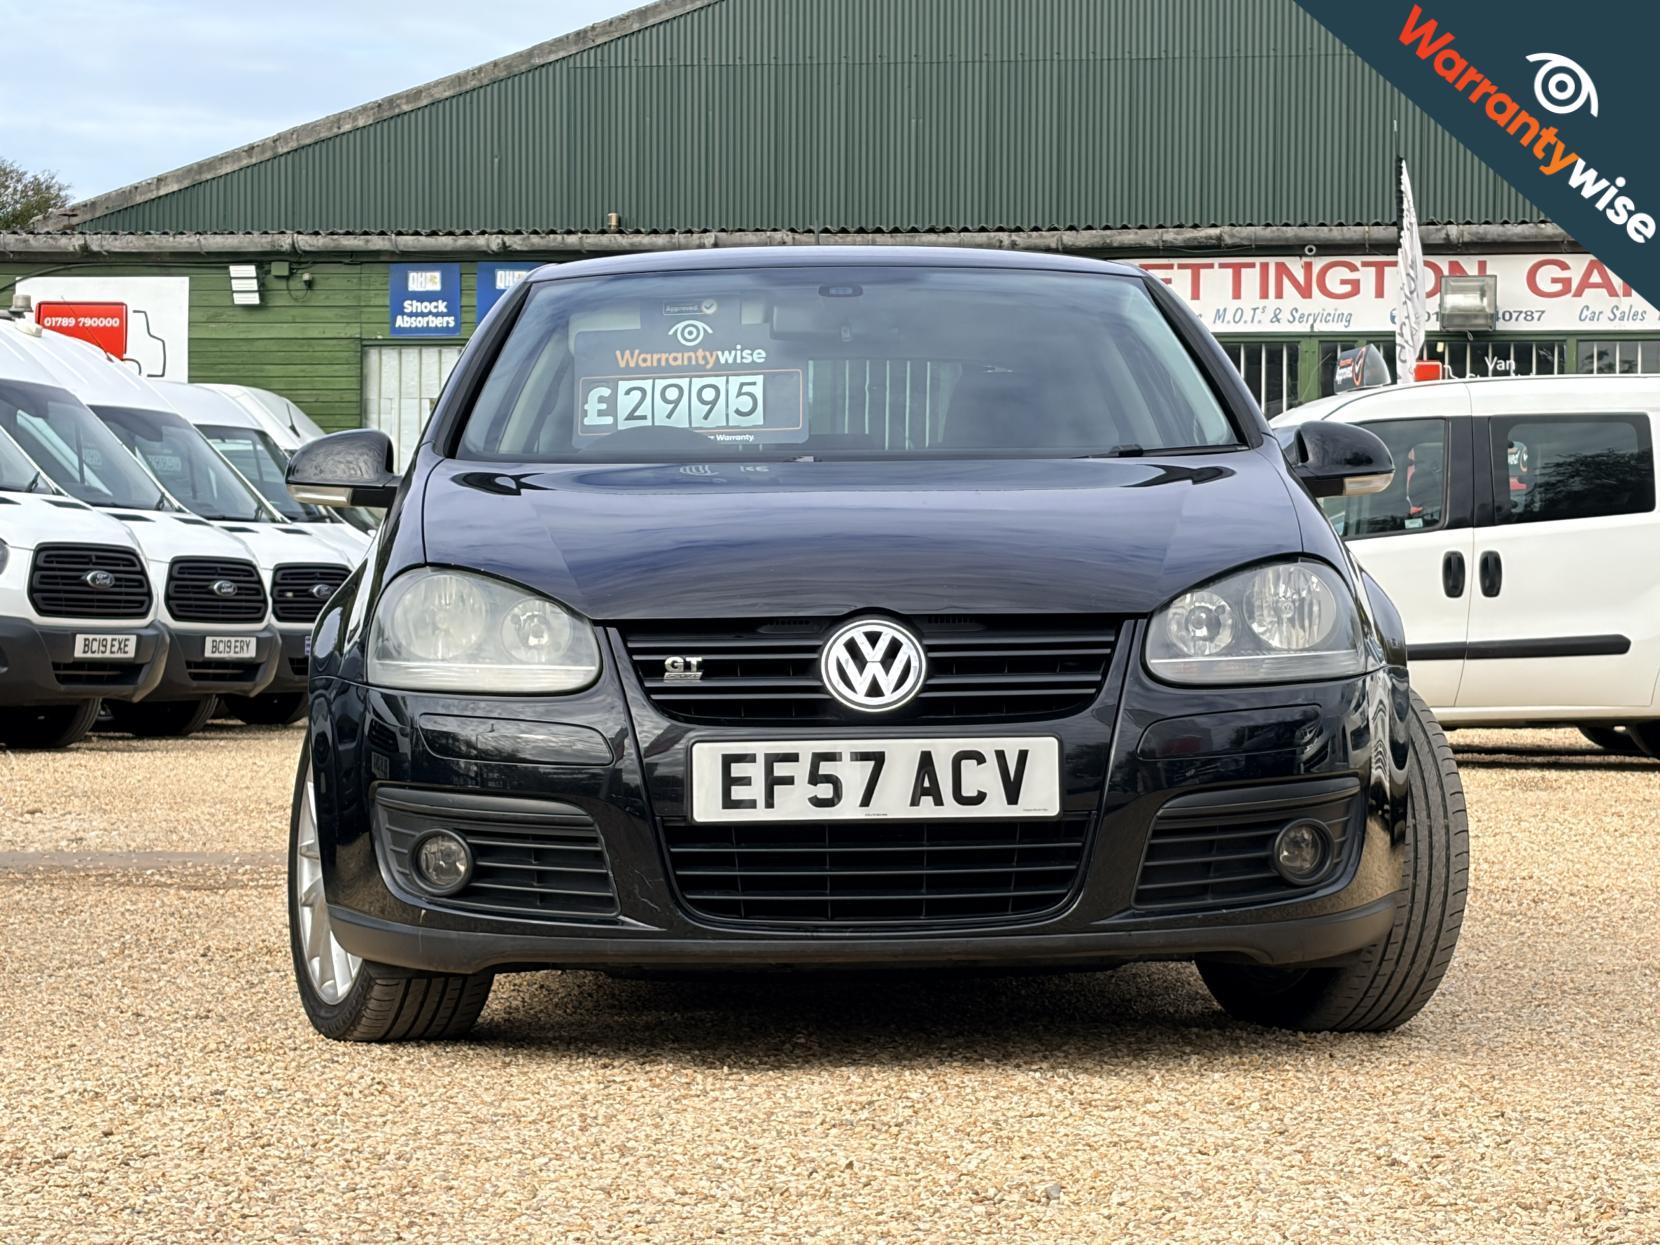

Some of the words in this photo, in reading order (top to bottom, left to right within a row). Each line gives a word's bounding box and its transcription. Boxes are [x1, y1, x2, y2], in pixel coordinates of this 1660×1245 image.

[403, 300, 448, 313] Shock
[1578, 304, 1603, 322] Car
[1607, 304, 1647, 322] Sales
[44, 317, 76, 327] 01789
[79, 317, 120, 327] 790000
[395, 315, 455, 328] Absorbers
[1270, 307, 1282, 324] &
[1287, 306, 1353, 329] Servicing
[616, 344, 767, 369] Warrantywise
[1484, 356, 1516, 371] Van
[716, 433, 754, 442] Warranty
[82, 638, 107, 654] BC19
[110, 638, 130, 654] EXE
[211, 639, 232, 654] BC19
[233, 639, 251, 654] ERY
[664, 656, 703, 672] GT
[721, 751, 886, 809] EF57
[909, 749, 1030, 807] ACV
